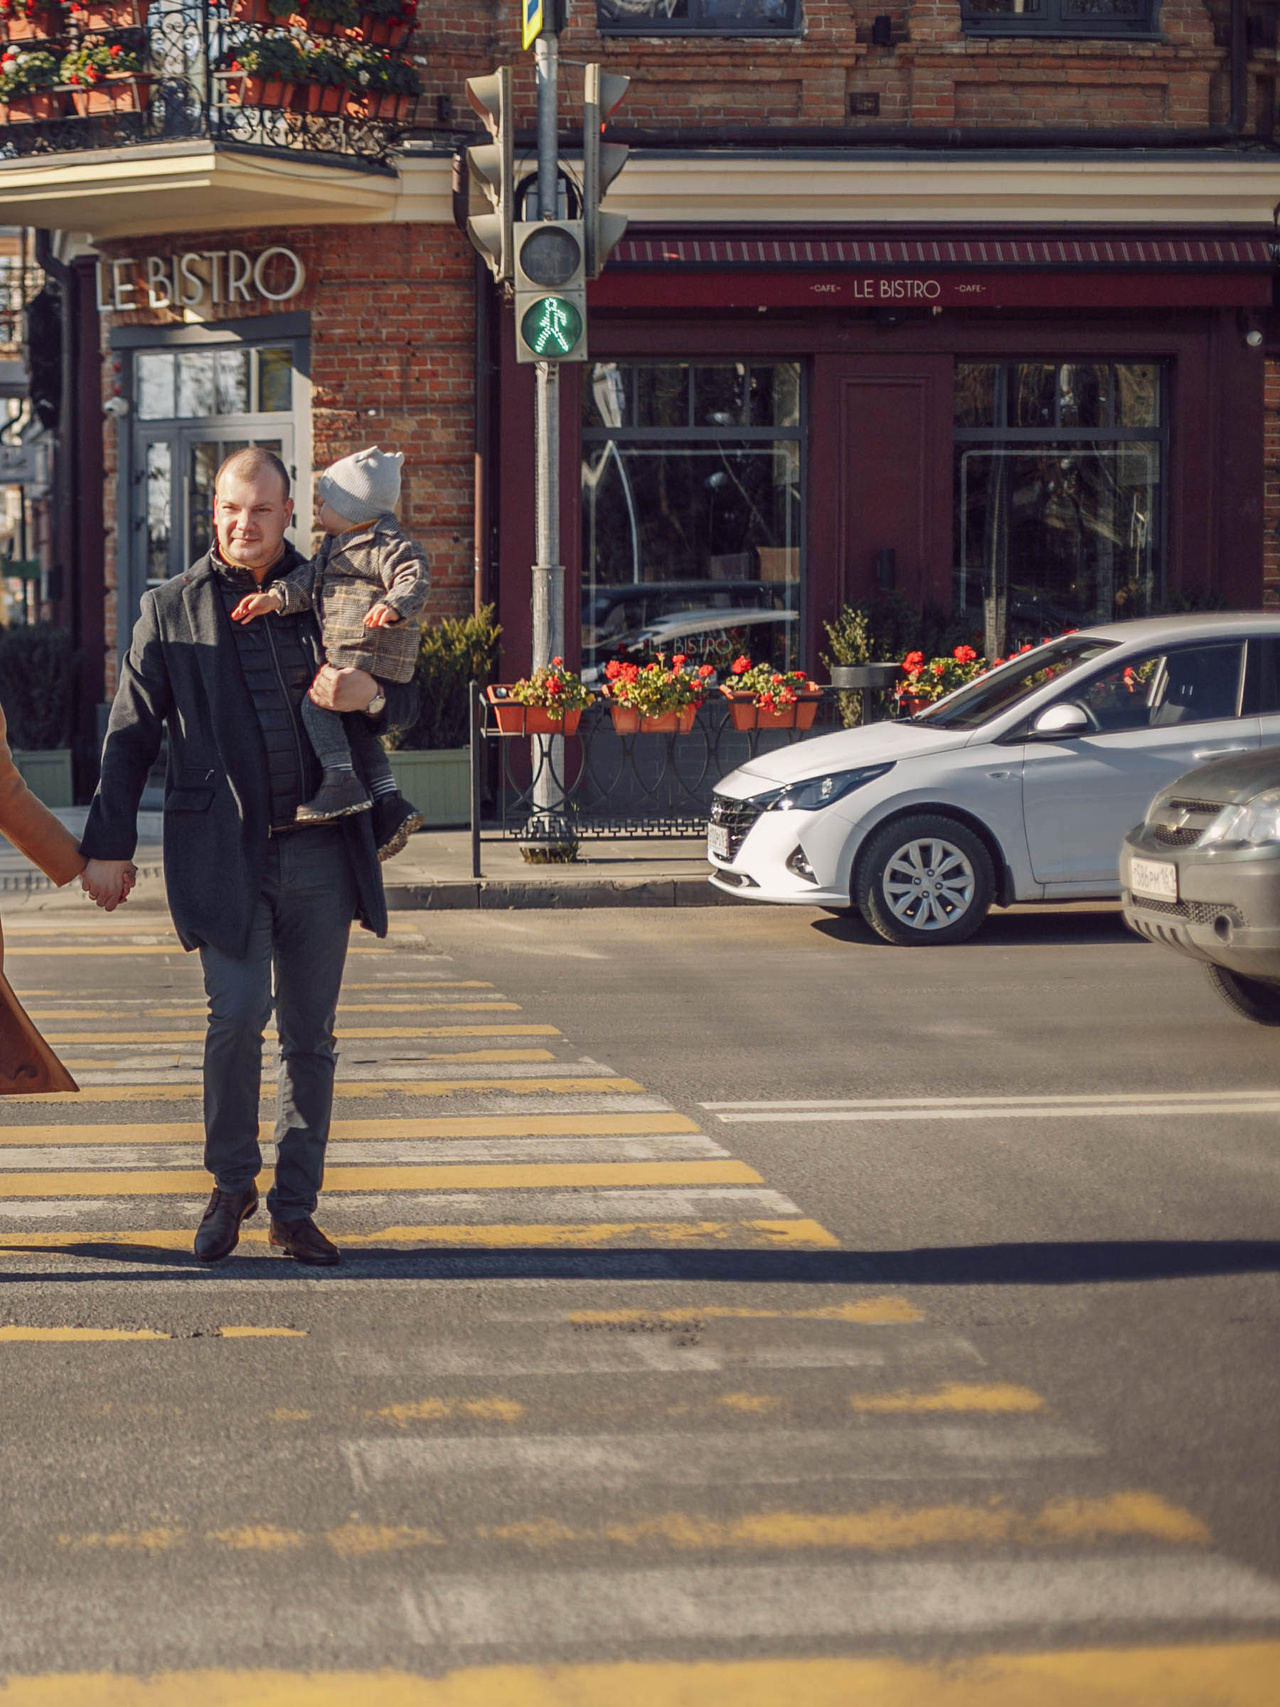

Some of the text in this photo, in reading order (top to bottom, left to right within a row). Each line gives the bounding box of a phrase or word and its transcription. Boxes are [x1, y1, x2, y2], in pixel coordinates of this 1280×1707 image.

[96, 247, 305, 310] LE BISTRO
[854, 280, 874, 298] LE
[880, 280, 941, 298] BISTRO
[674, 638, 732, 655] BISTRO
